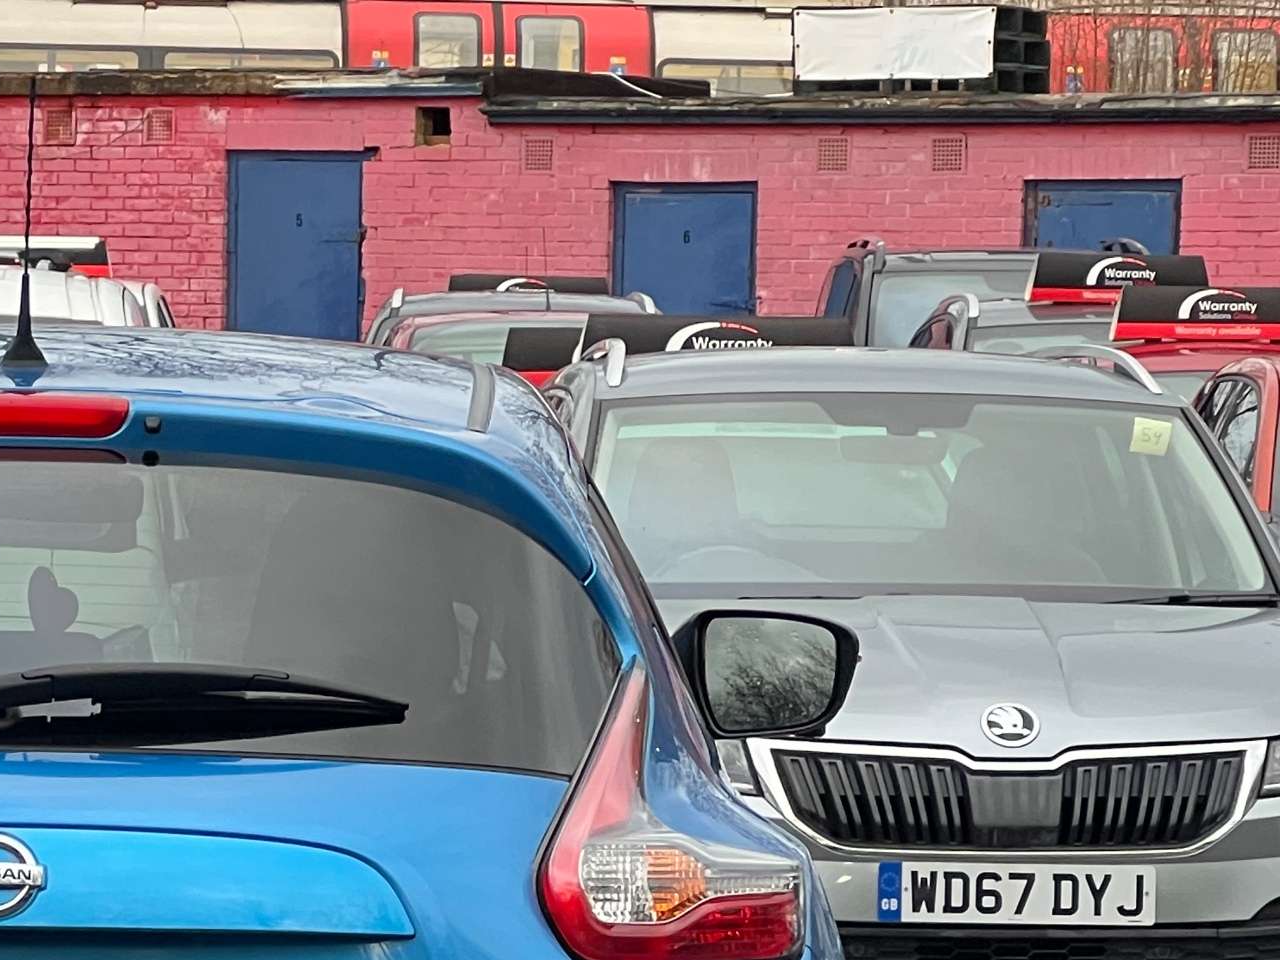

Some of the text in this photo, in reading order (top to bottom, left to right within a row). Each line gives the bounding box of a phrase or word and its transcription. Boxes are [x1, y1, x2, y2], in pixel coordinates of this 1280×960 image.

[296, 213, 303, 227] 5
[683, 230, 690, 244] 6
[1105, 267, 1156, 281] Warranty
[1199, 300, 1257, 314] Warranty
[881, 870, 1144, 918] GB WD67 DYJ
